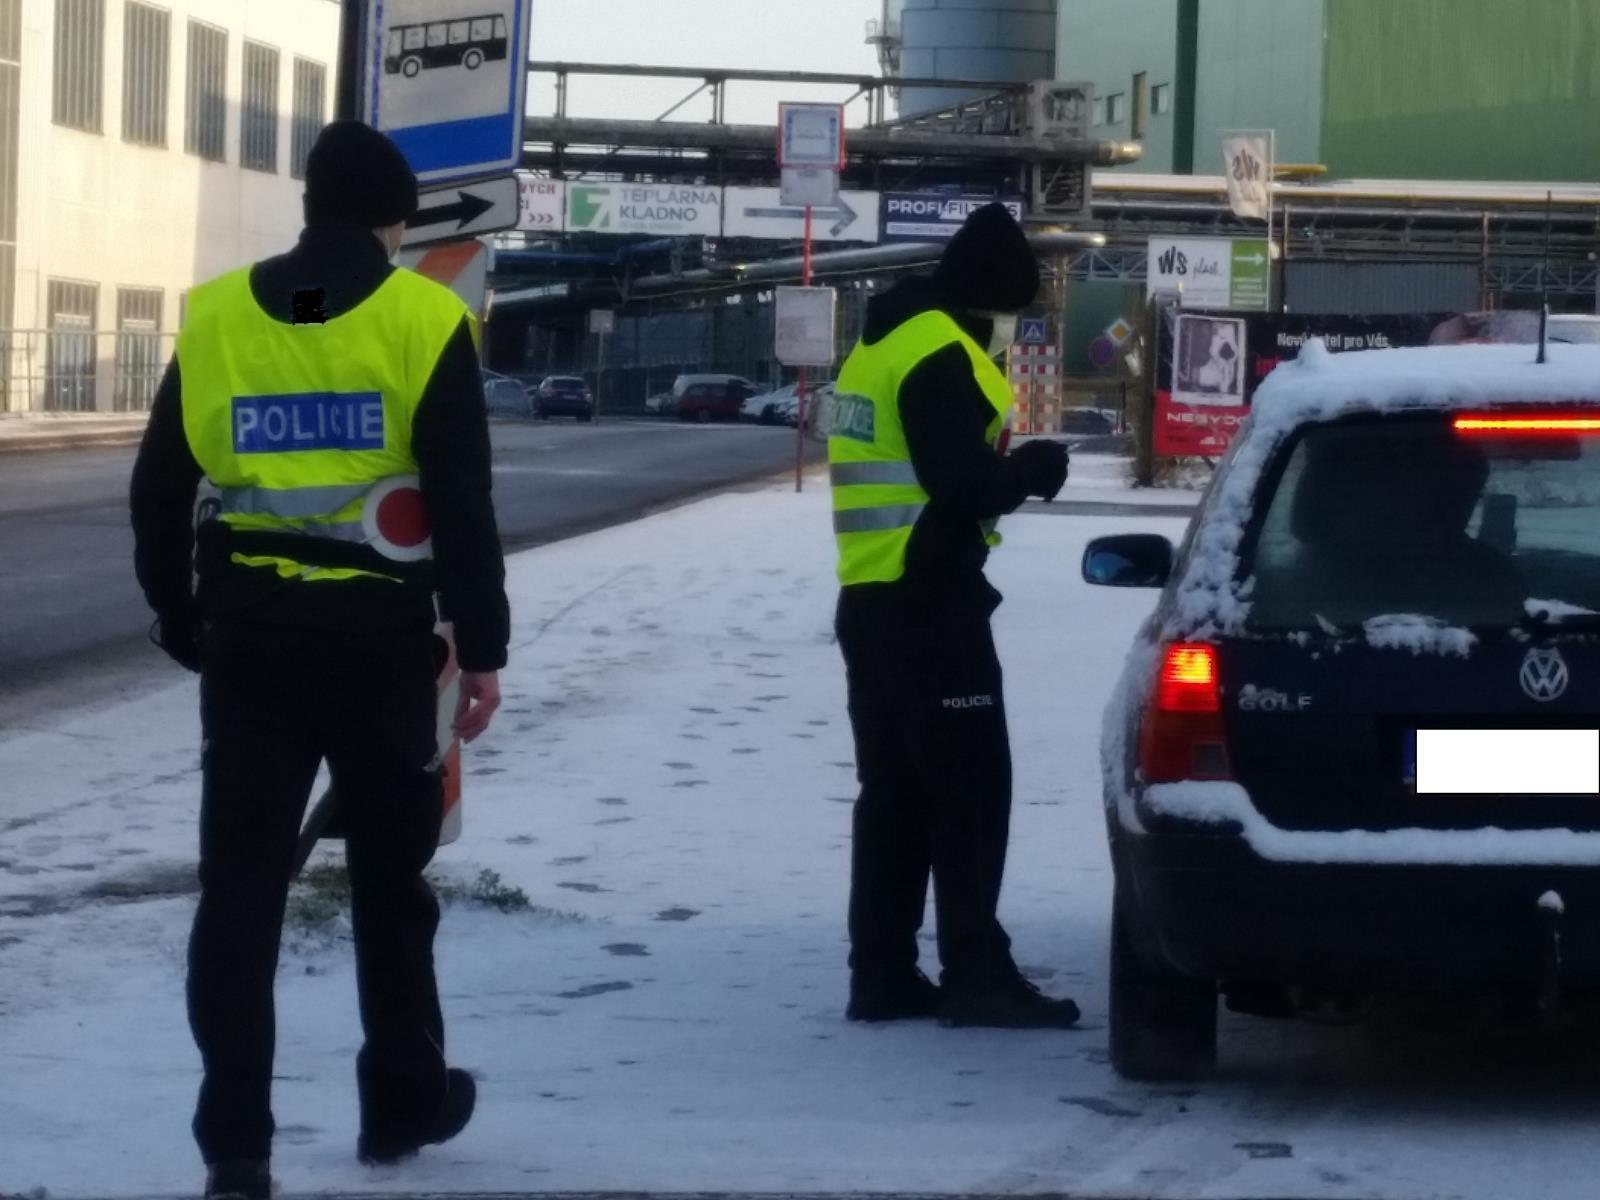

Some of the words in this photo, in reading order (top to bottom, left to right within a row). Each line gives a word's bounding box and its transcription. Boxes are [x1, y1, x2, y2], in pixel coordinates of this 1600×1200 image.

[619, 186, 718, 205] TEPLÁRNA
[619, 205, 698, 222] KLADNO
[1158, 245, 1188, 275] WS
[1344, 337, 1364, 350] pro
[236, 402, 383, 443] POLICIE
[942, 694, 993, 709] POLICIE
[1238, 693, 1312, 711] GOLF
